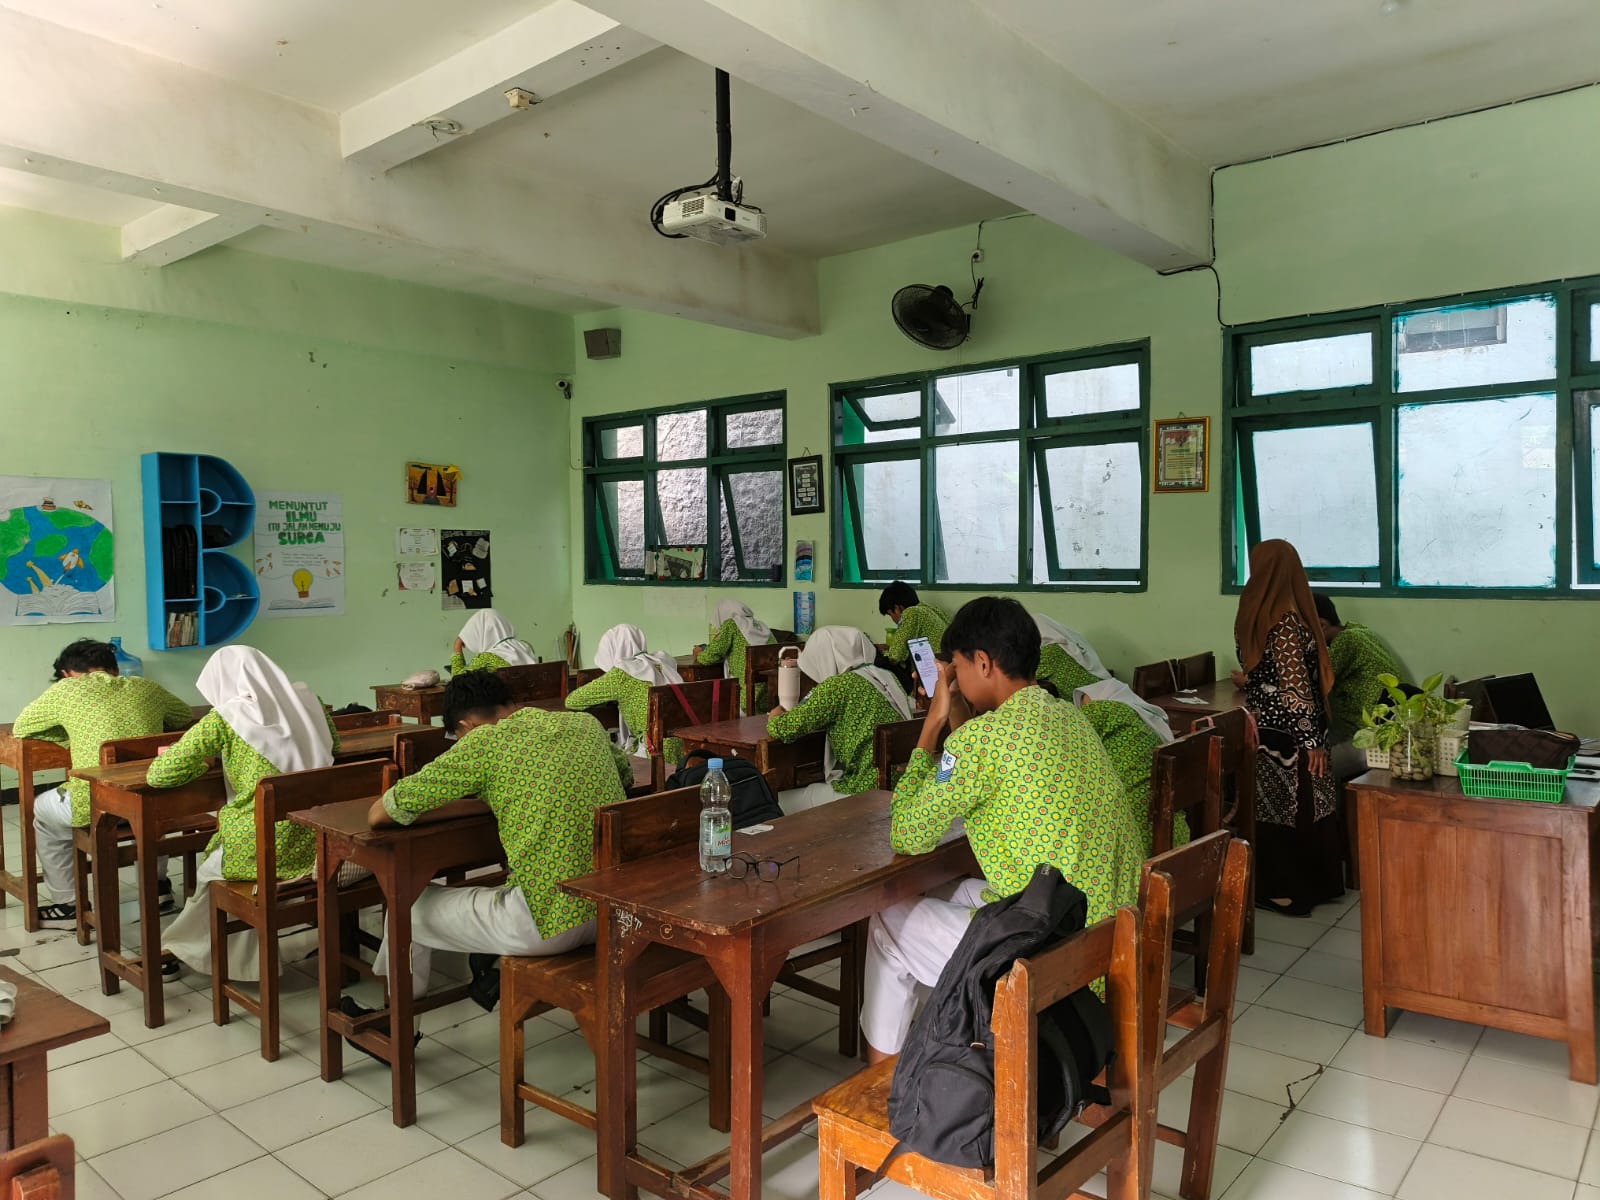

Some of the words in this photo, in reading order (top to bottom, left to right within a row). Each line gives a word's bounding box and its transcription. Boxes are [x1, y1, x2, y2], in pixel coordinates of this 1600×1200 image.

[268, 500, 328, 511] MENUNTUT
[286, 511, 317, 522] ILMU
[278, 531, 325, 545] SURGA
